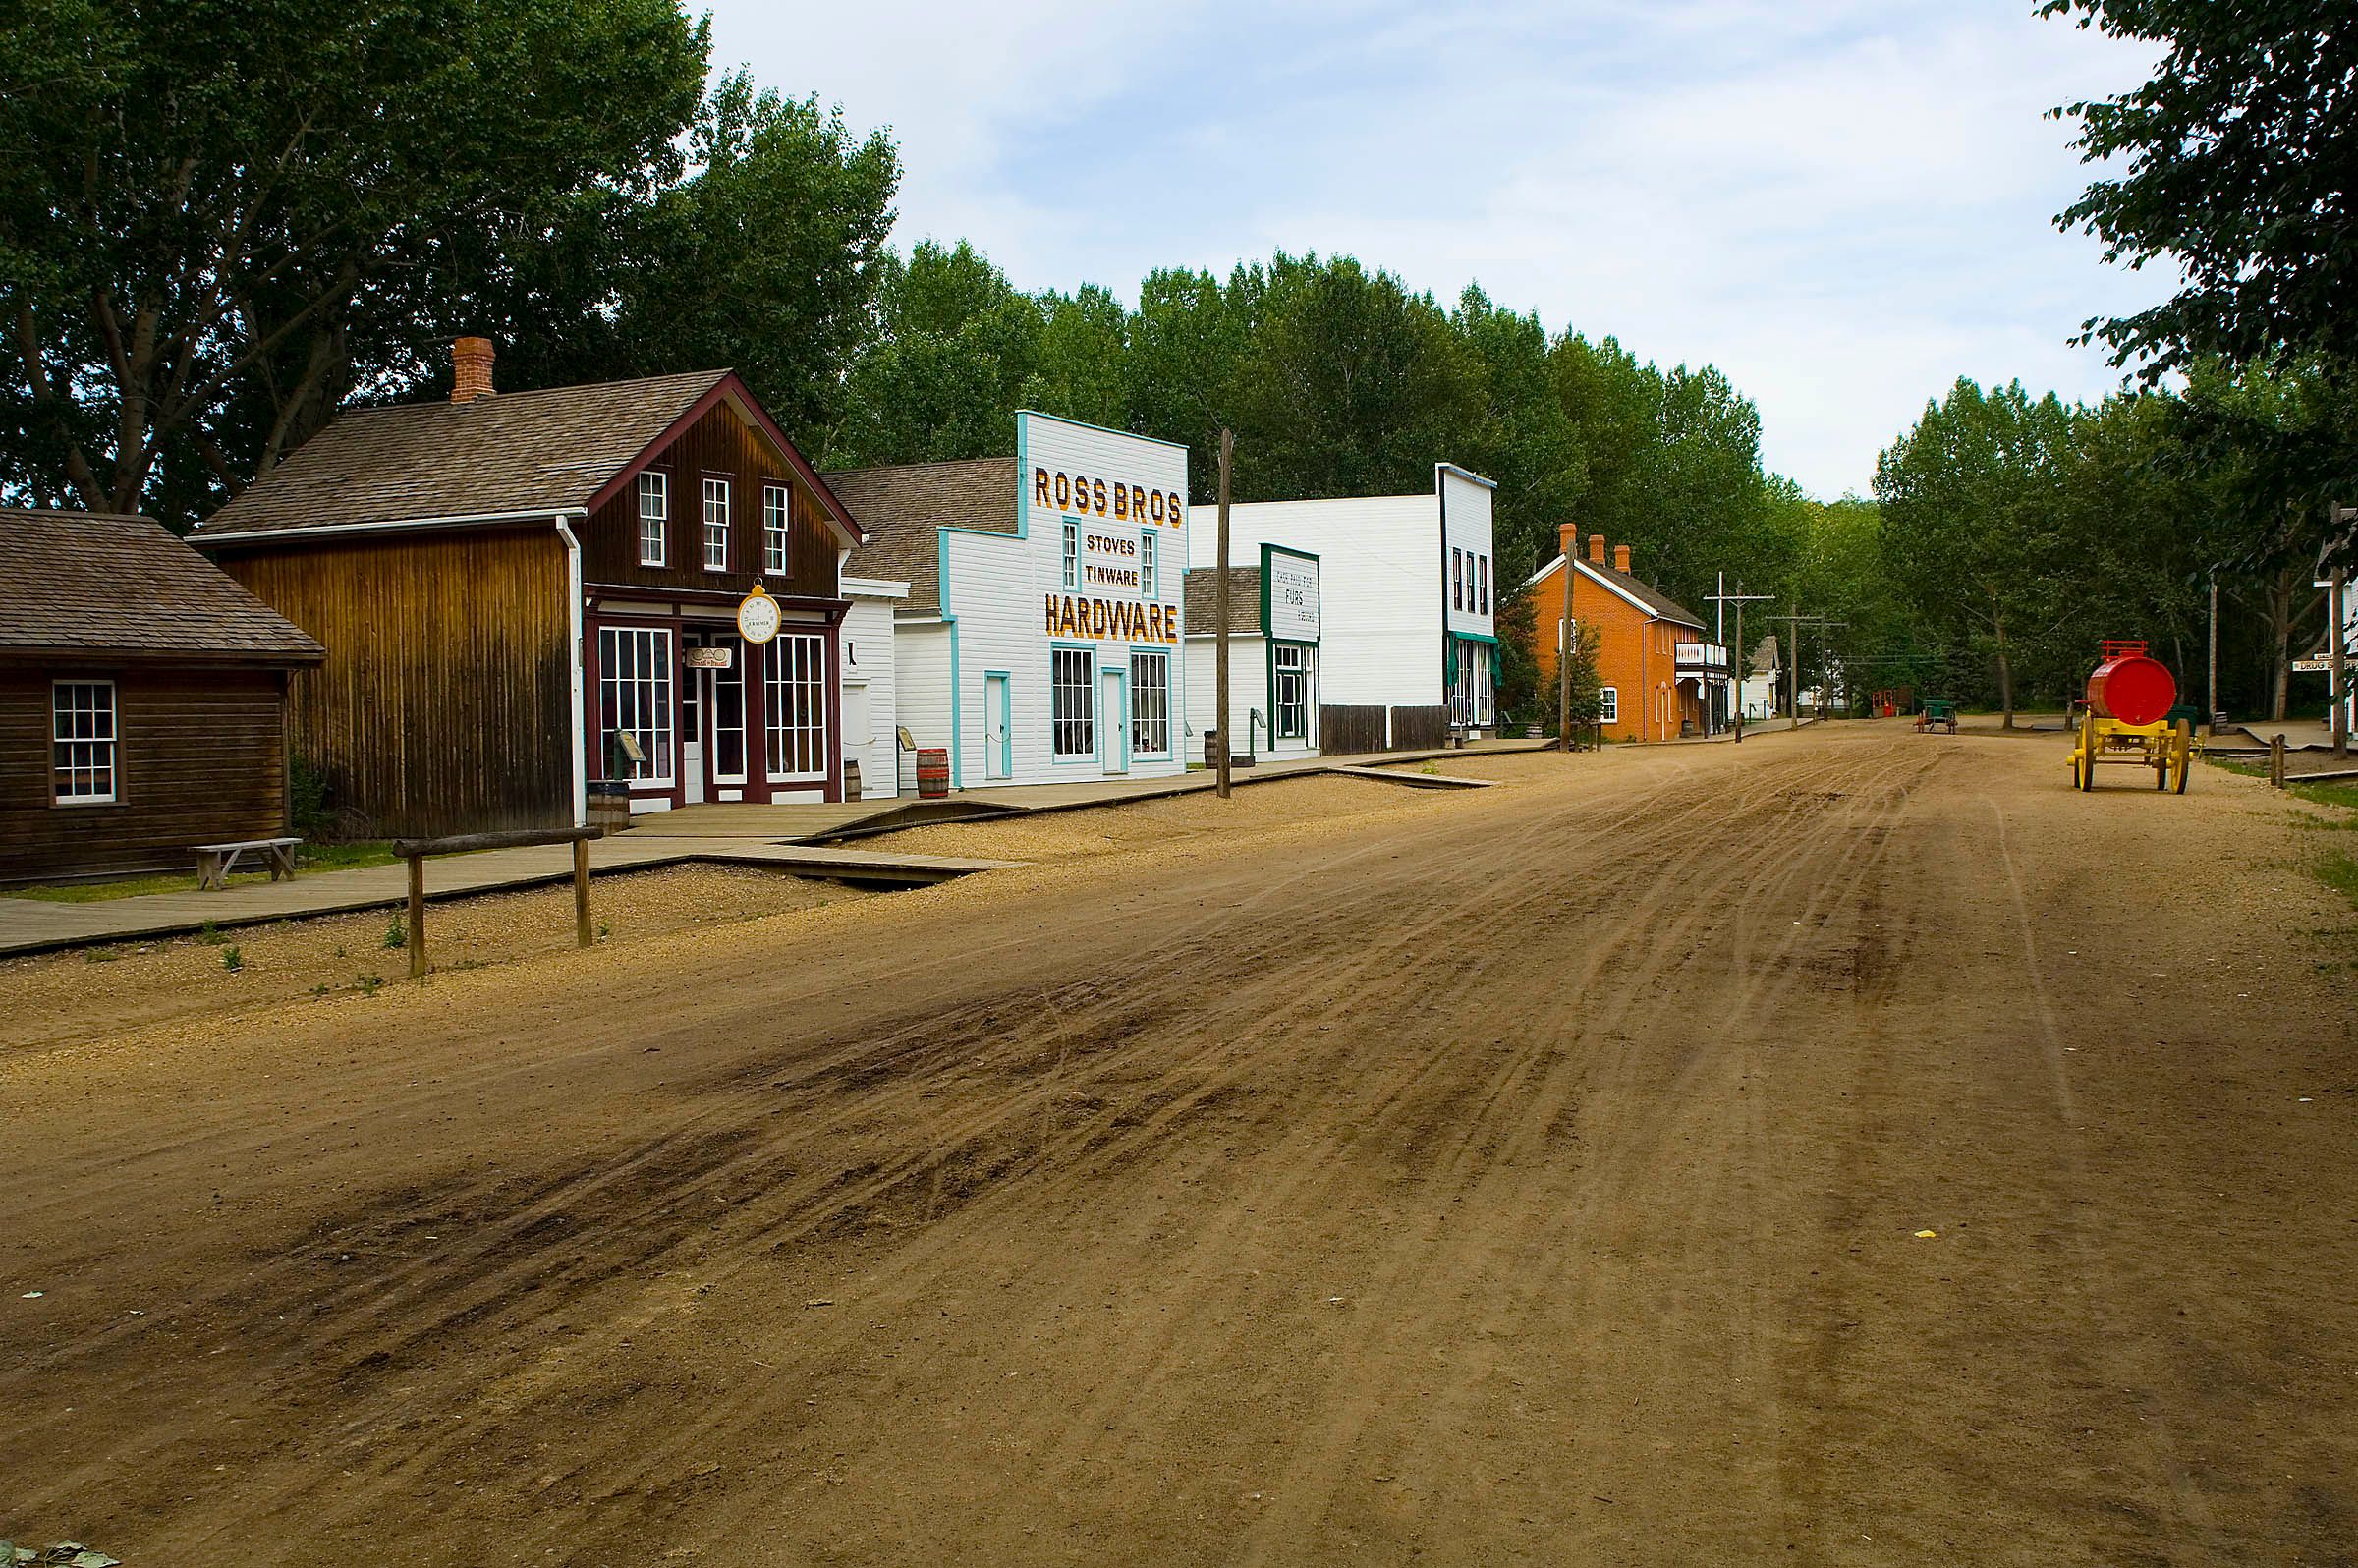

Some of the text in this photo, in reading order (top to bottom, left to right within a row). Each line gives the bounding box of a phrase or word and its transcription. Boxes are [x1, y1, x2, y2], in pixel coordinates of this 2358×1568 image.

[1035, 467, 1183, 529] ROSS BROS
[1087, 534, 1135, 557] STOVES
[1085, 565, 1139, 587] TINWARE
[1286, 589, 1304, 605] FURS
[1044, 593, 1178, 644] HARDWARE
[2300, 660, 2325, 670] DRUG
